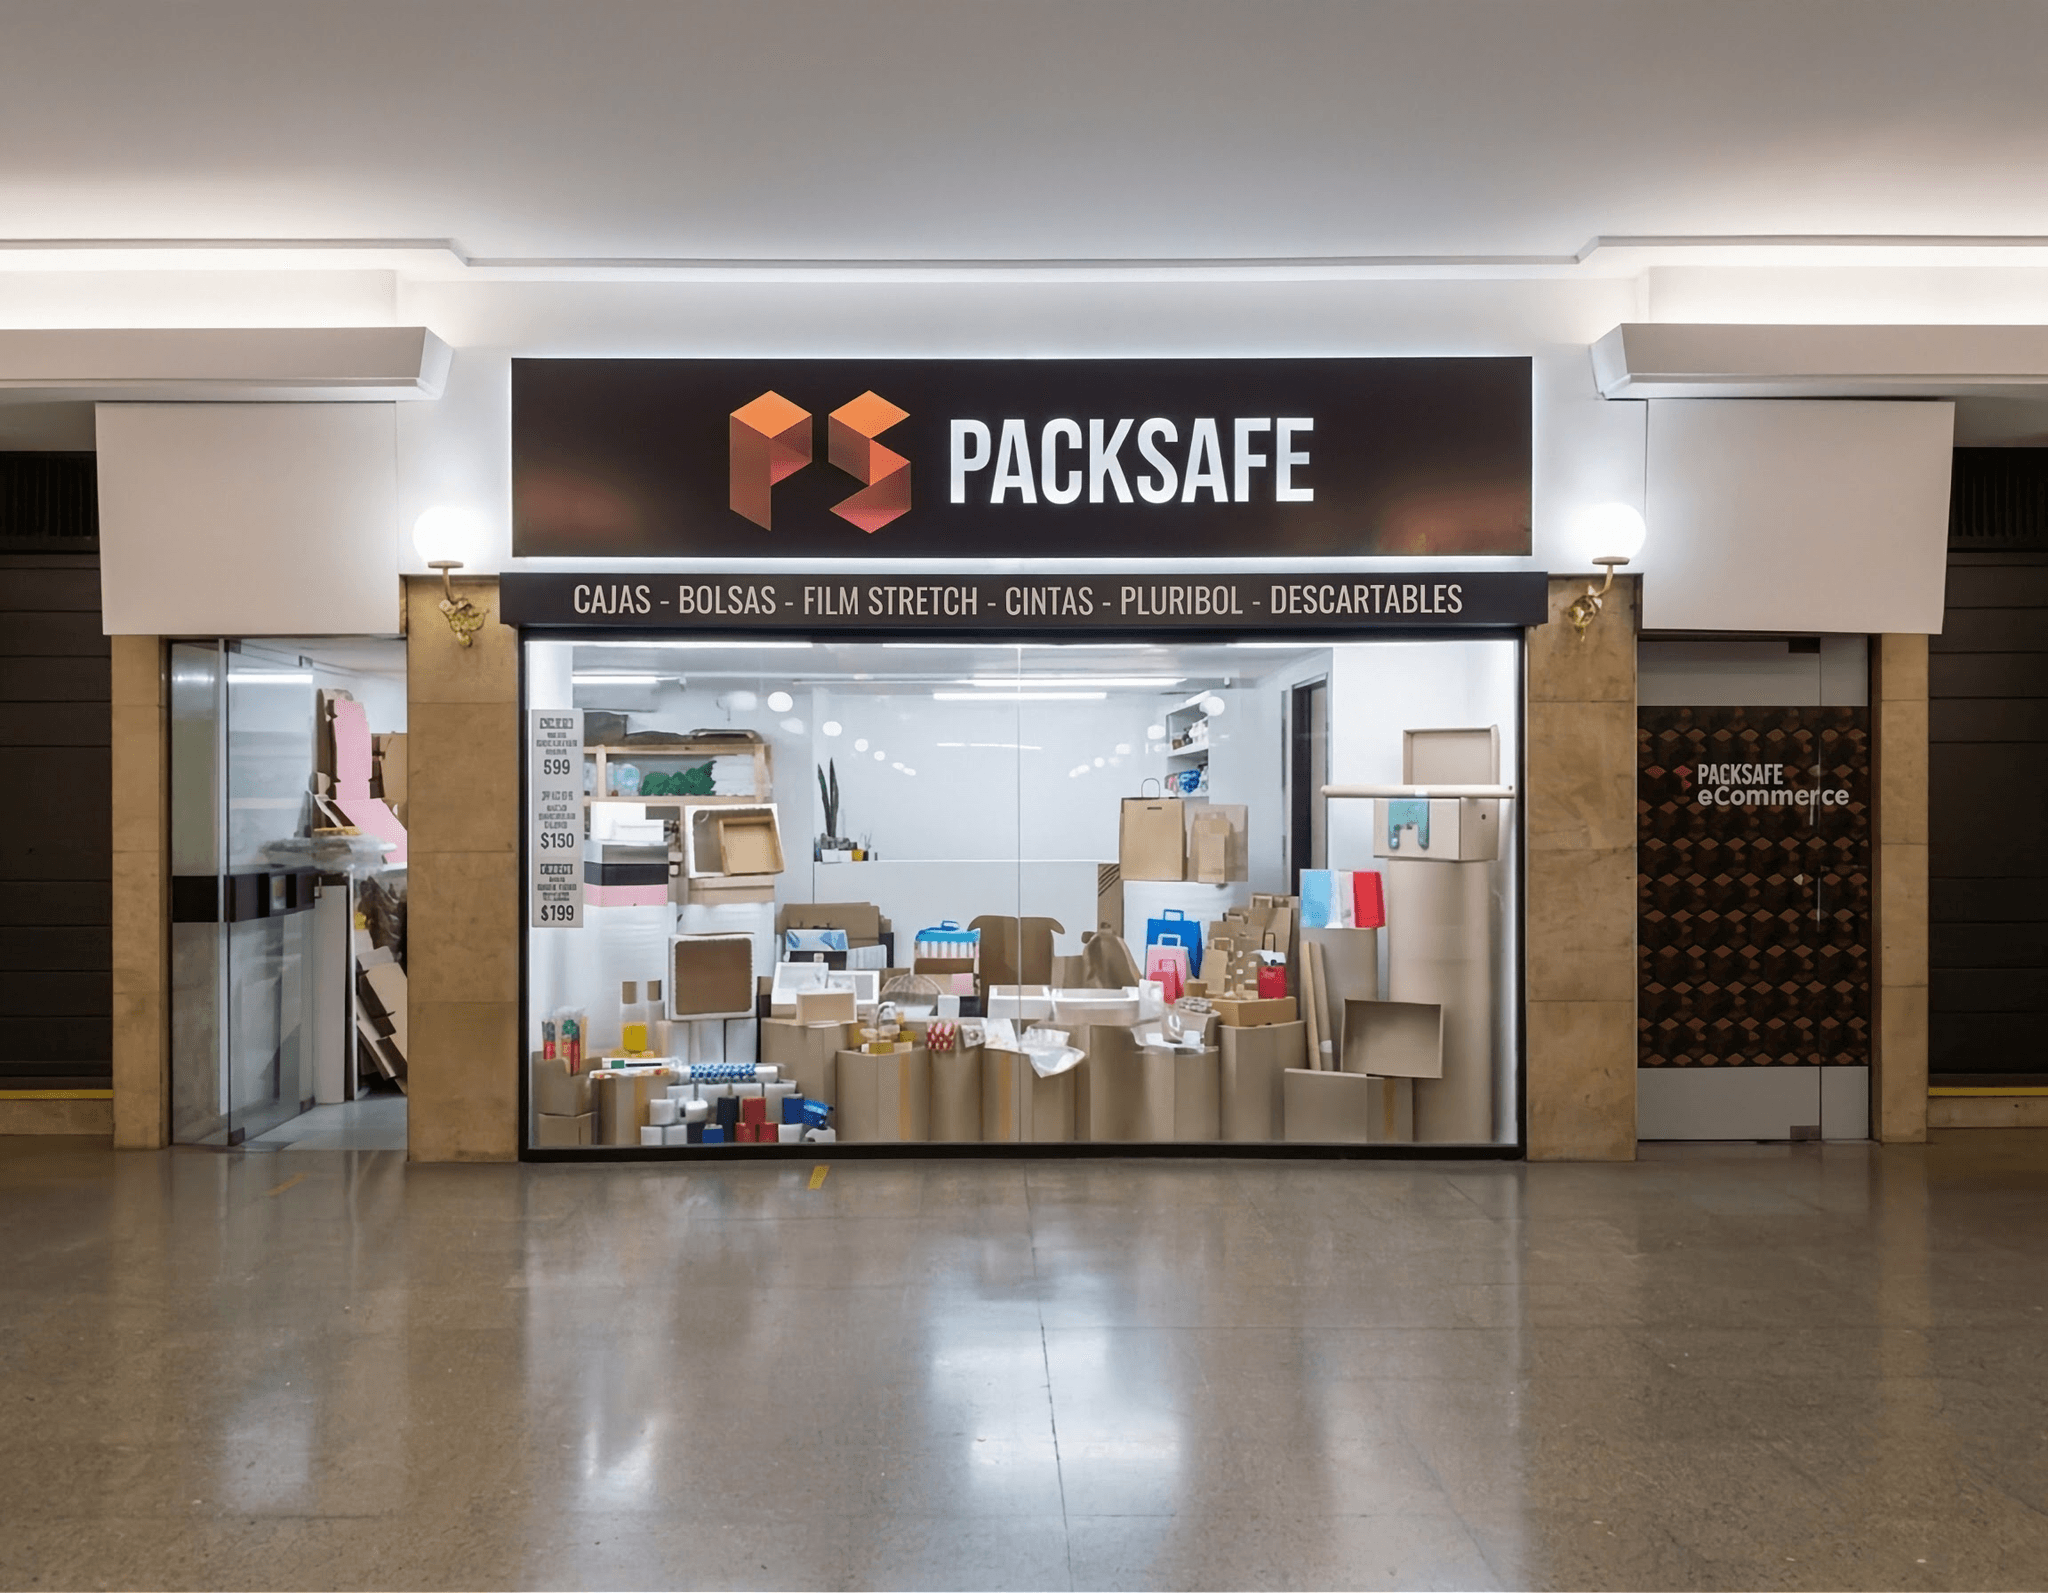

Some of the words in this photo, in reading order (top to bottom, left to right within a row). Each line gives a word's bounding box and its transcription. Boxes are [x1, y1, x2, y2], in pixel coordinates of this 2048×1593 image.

[949, 417, 1314, 505] PACKSAFE
[574, 584, 651, 615] CAJAS
[678, 585, 777, 615] BOLSAS
[804, 586, 859, 615] FILM
[868, 586, 978, 616] STRETCH
[1005, 586, 1094, 616] CINTAS
[1121, 585, 1244, 616] PLURIBOL
[1271, 584, 1463, 614] DESCARTABLES
[1697, 763, 1784, 785] PACKSAFE
[1697, 785, 1850, 806] eCommerce
[540, 832, 575, 850] $150
[540, 904, 575, 922] $199
